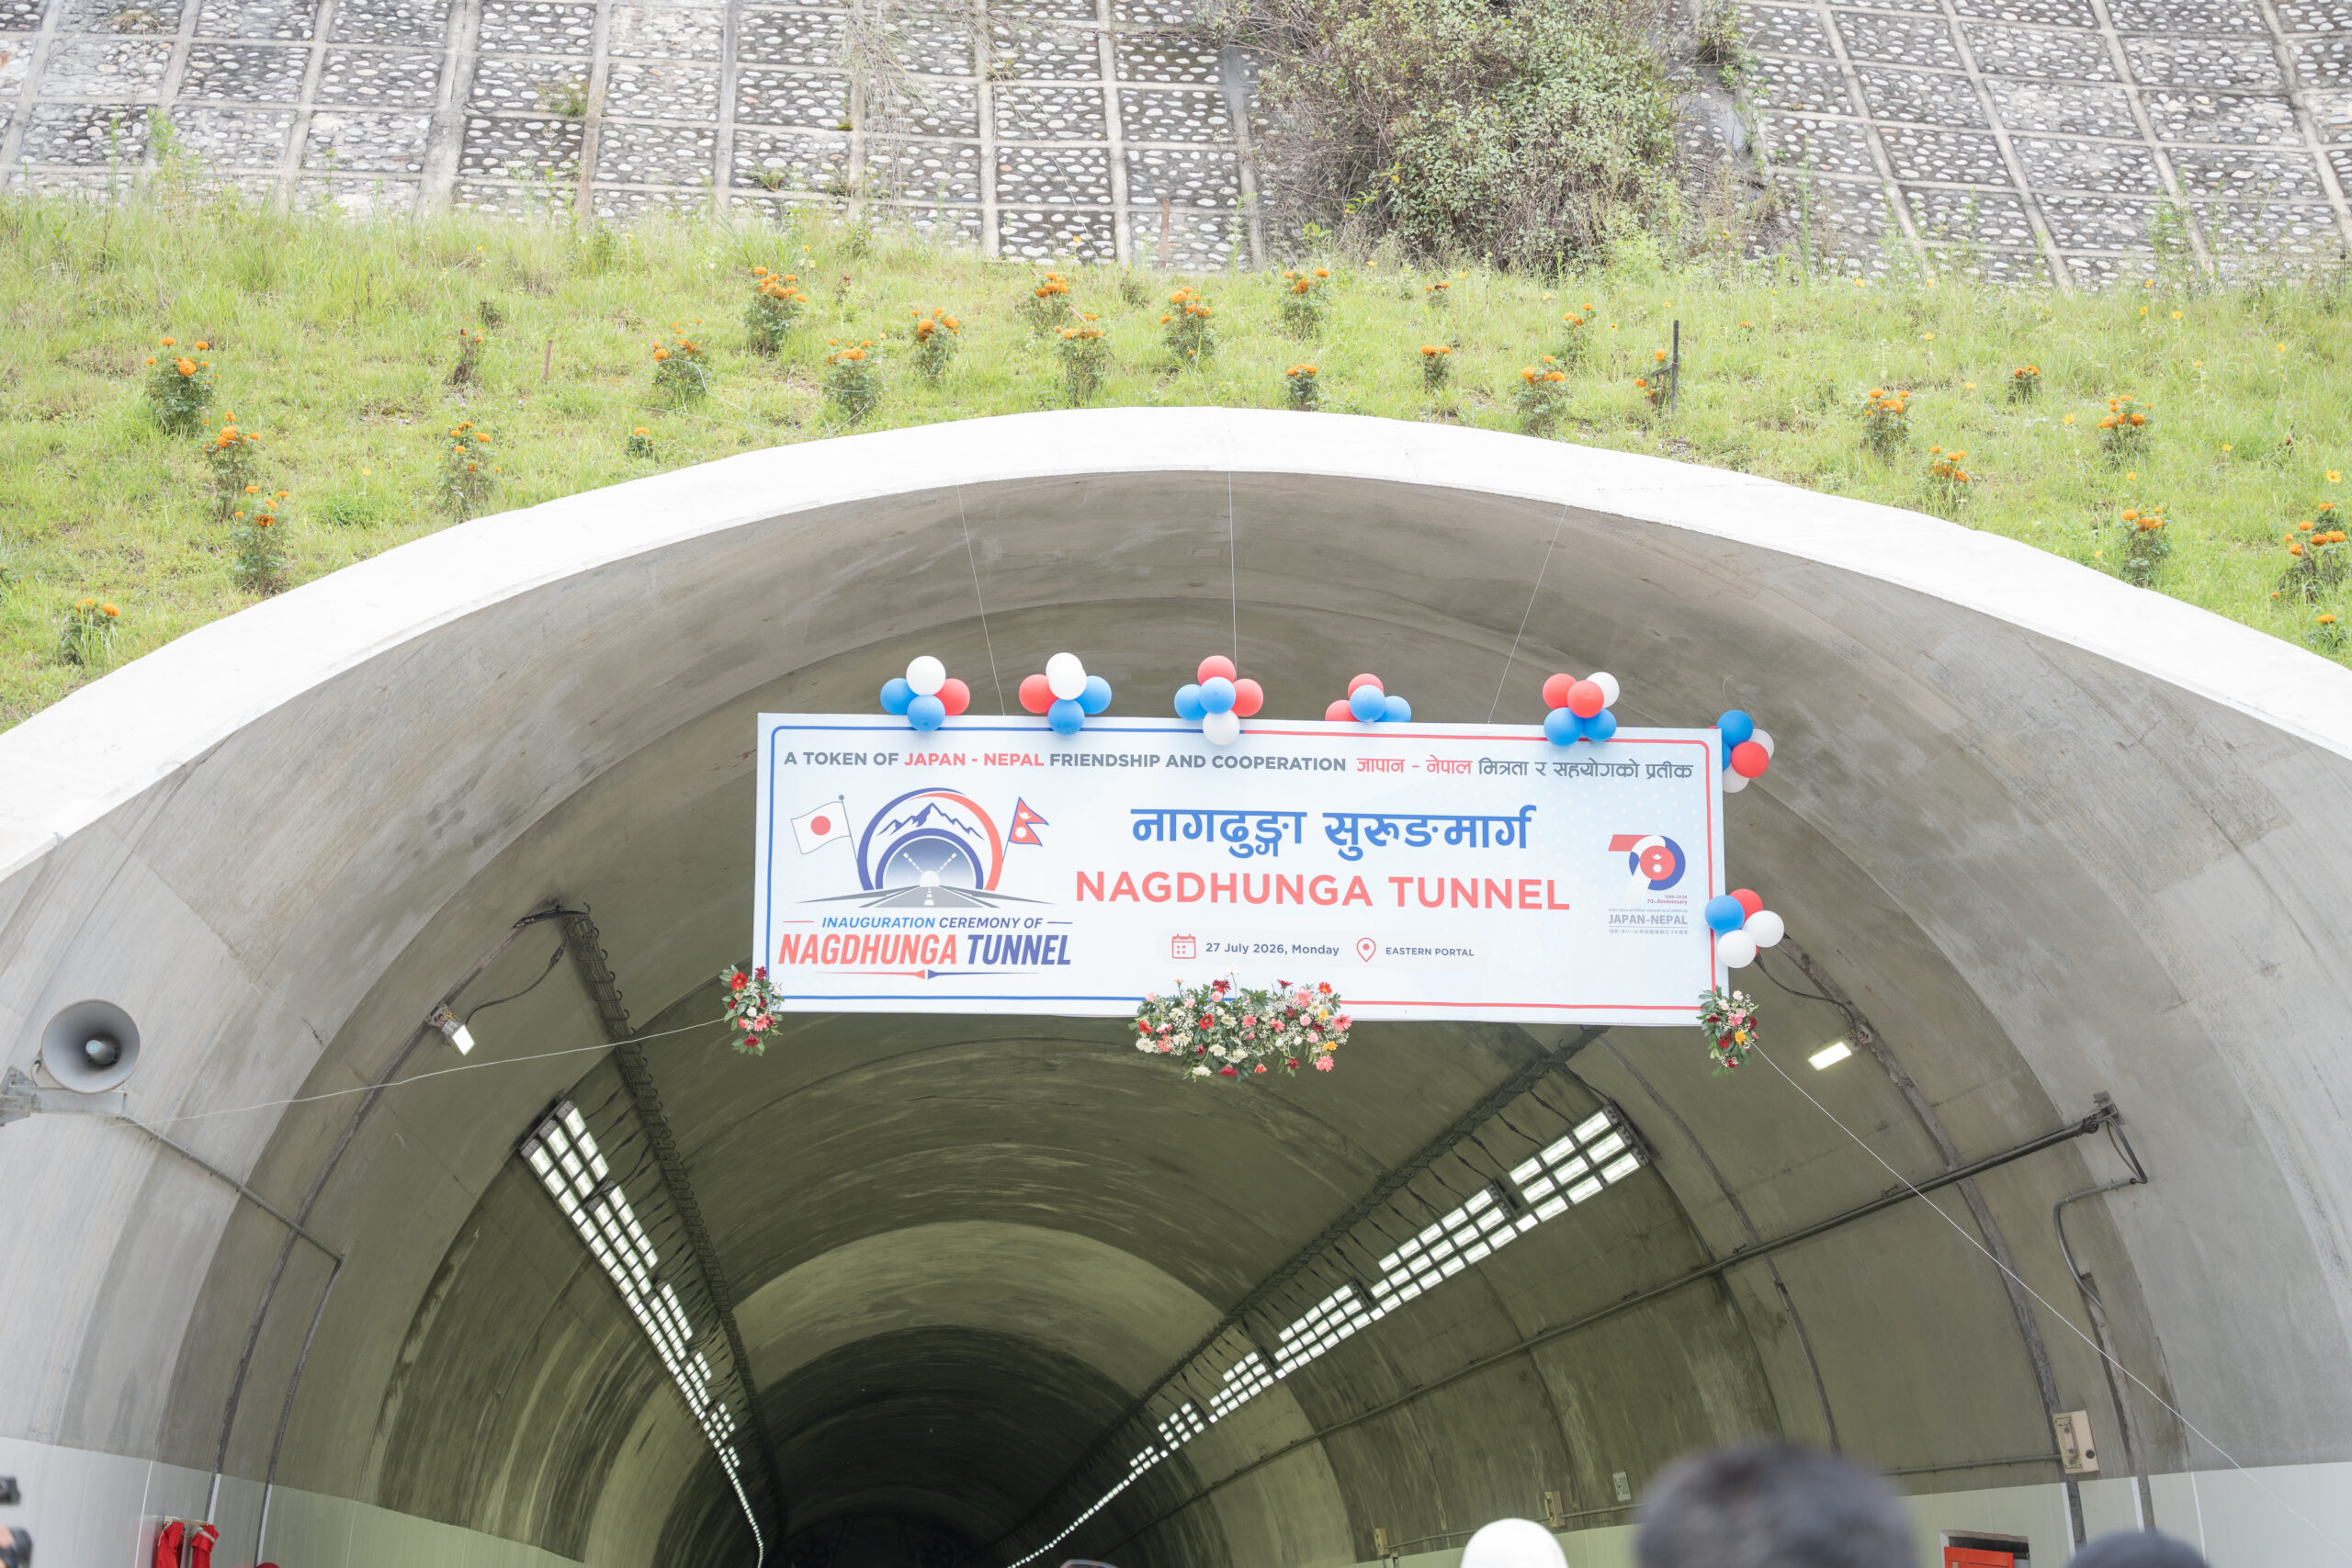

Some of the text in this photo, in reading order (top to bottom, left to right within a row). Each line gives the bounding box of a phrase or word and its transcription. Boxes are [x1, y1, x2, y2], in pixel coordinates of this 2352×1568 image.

[784, 751, 797, 765] A
[803, 751, 866, 766] TOKEN
[873, 751, 899, 766] OF
[904, 752, 966, 766] JAPAN
[984, 753, 1044, 767] NEPAL
[1050, 753, 1159, 768] FRIENDSHIP
[1166, 754, 1205, 769] AND
[1212, 755, 1346, 772] COOPERATION
[1356, 758, 1406, 773] जापान
[1425, 754, 1473, 775] नेपाल
[1478, 757, 1529, 776] मित्रता
[1534, 761, 1547, 776] र
[1553, 758, 1640, 779] सहयोगको
[1645, 761, 1694, 780] प्रतीक
[1130, 804, 1537, 862] नागढुङ्गा सुरूङमार्ग
[1076, 870, 1570, 910] NAGDHUNGA TUNNEL
[821, 917, 1044, 929] INAUGURATION CEREMONY OF
[1609, 914, 1689, 925] JAPAN-NEPAL
[778, 933, 1071, 966] NAGDHUNGA TUNNEL
[1205, 942, 1340, 957] 27 July 2026, Monday
[1385, 947, 1476, 957] EASTERN PORTAL
